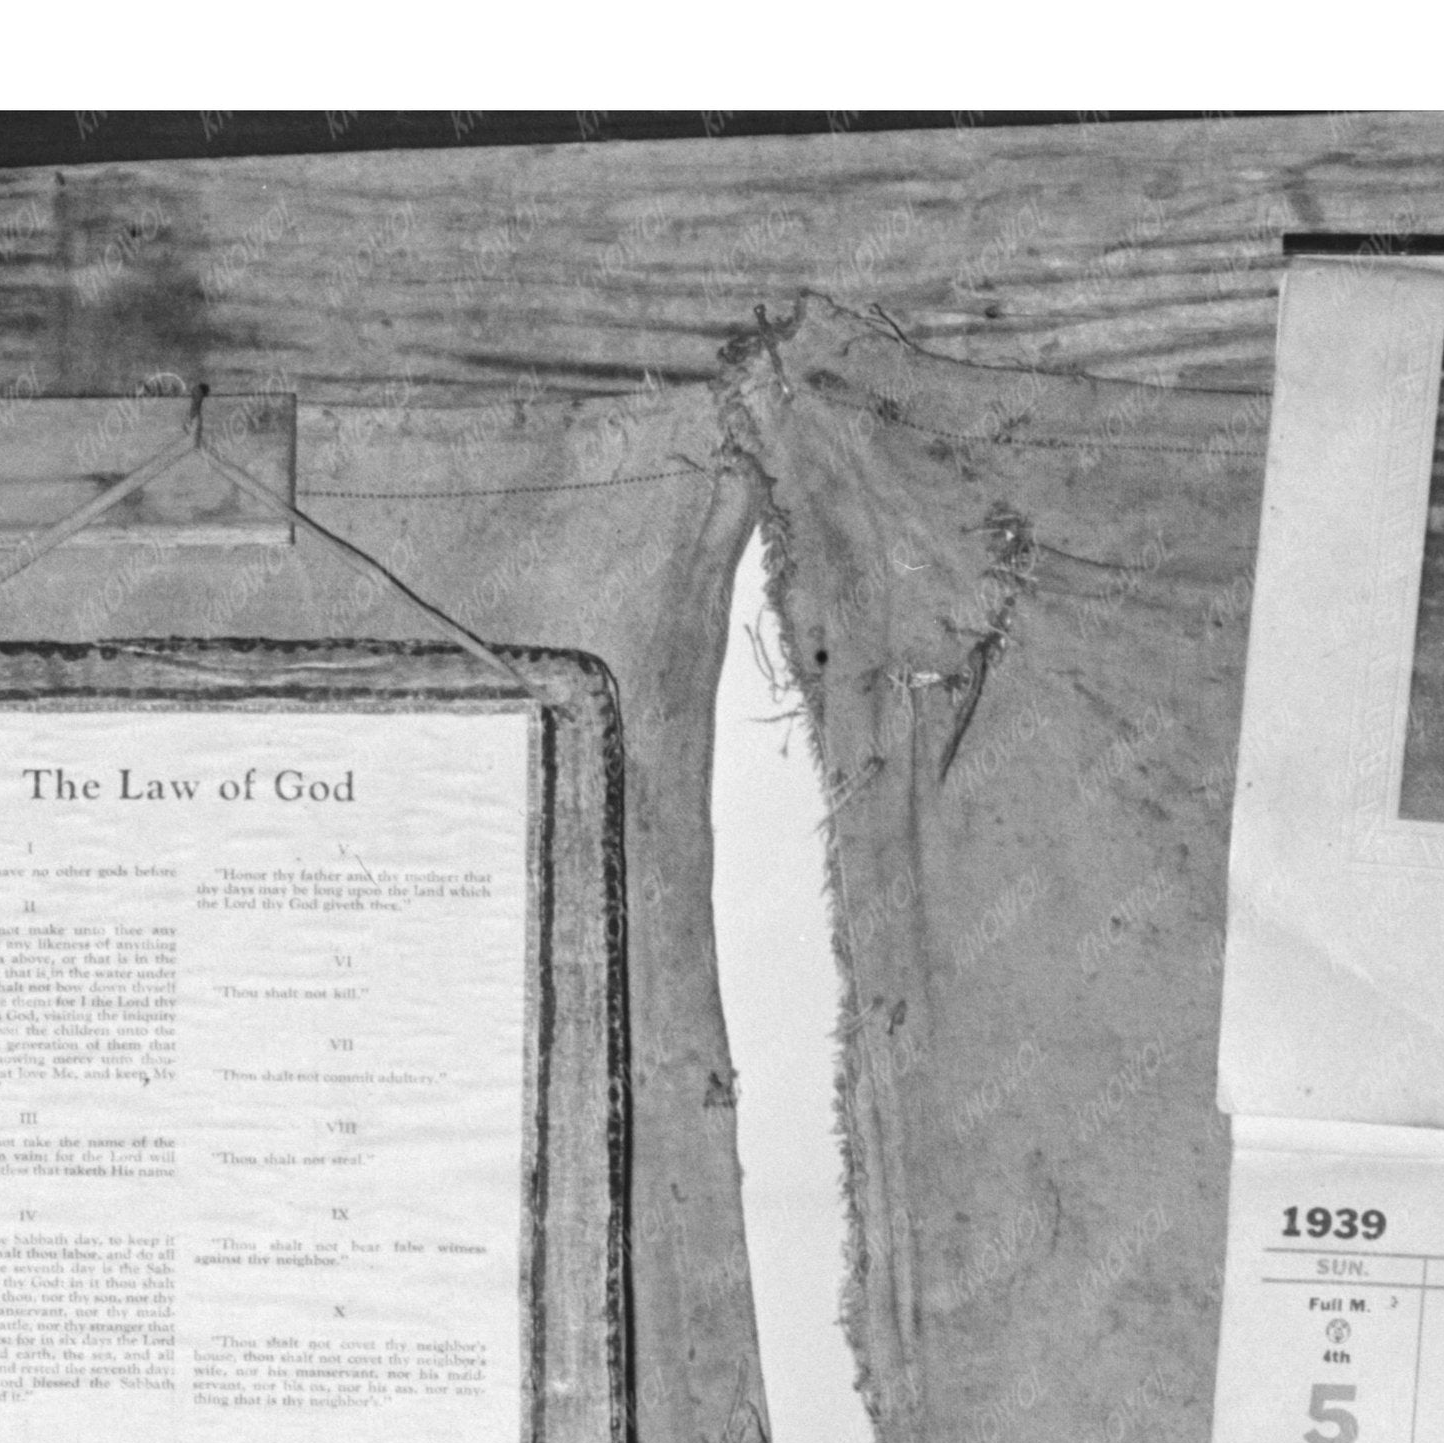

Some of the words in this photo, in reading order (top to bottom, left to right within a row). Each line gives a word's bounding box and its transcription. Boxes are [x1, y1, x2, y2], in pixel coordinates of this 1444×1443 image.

[22, 767, 101, 801] The
[118, 768, 201, 801] Law
[218, 768, 257, 802] of
[274, 769, 357, 802] God
[98, 865, 128, 880] gods
[1281, 1205, 1388, 1241] 1939
[1316, 1257, 1371, 1277] SUN.
[1308, 1297, 1344, 1312] Full
[1349, 1297, 1371, 1313] M.
[1322, 1350, 1351, 1364] 4th
